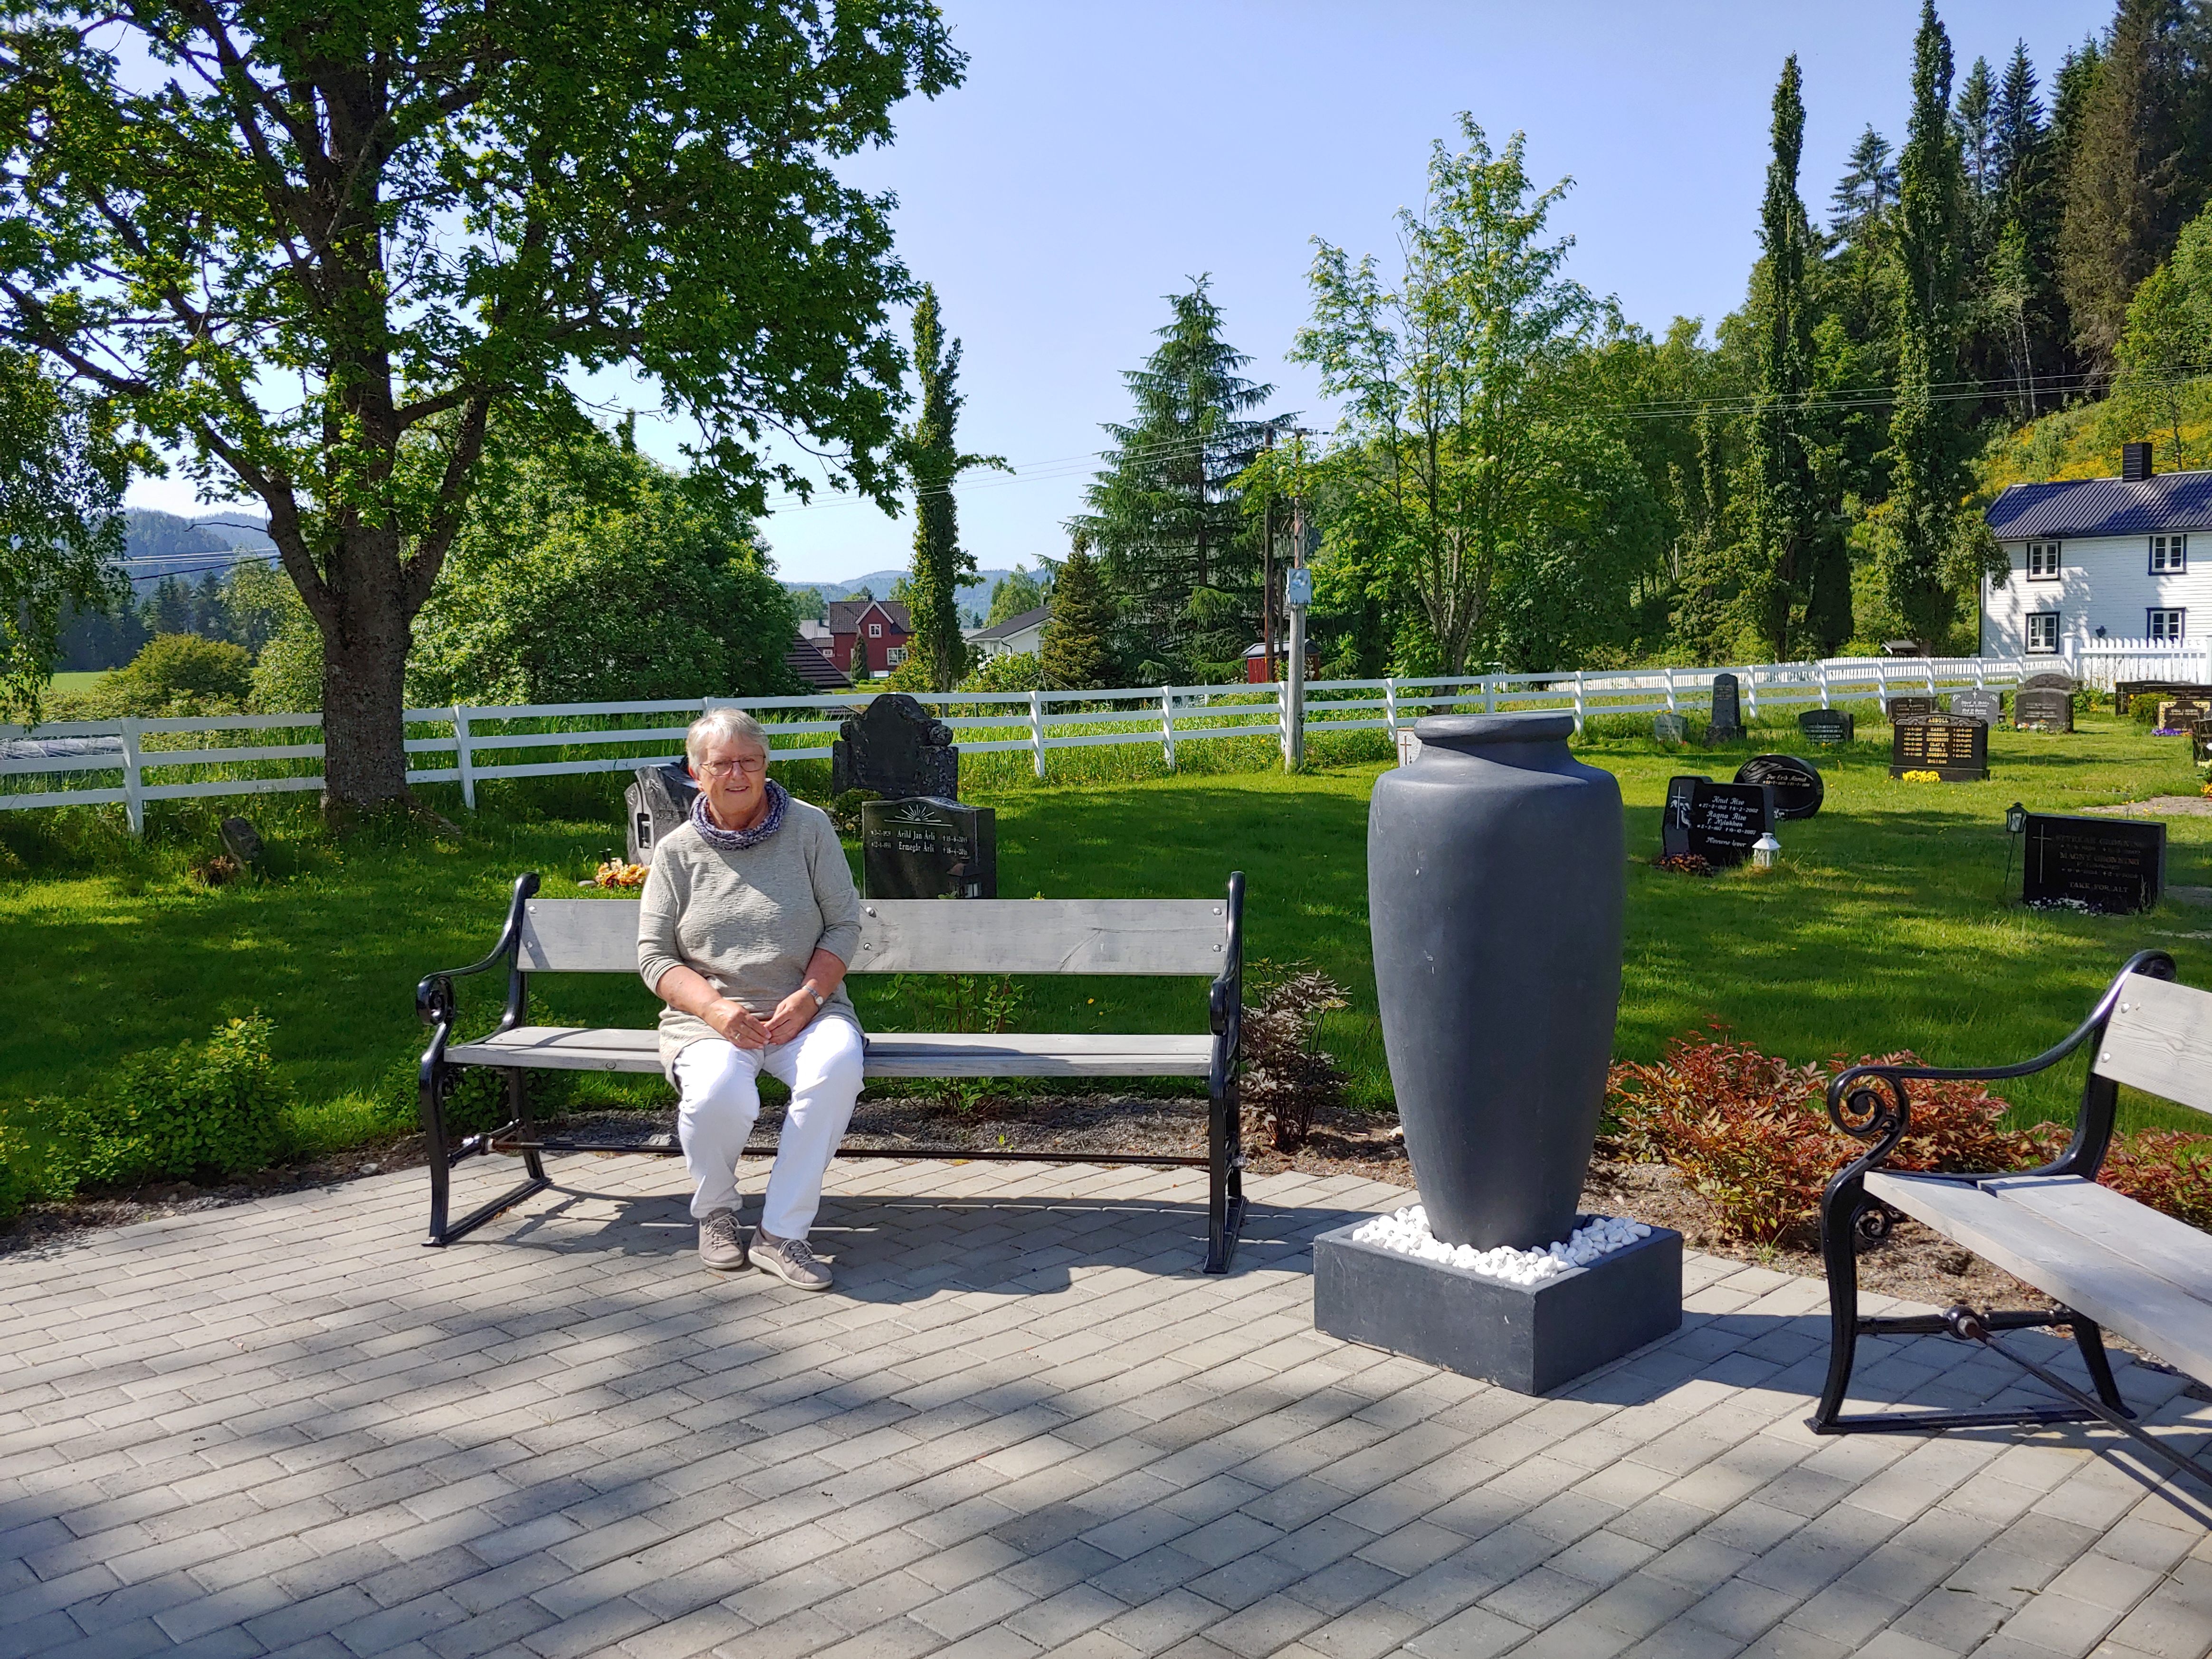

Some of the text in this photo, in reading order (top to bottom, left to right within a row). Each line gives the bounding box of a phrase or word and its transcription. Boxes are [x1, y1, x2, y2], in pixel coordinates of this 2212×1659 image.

[897, 830, 912, 838] Arild
[913, 830, 922, 840] Jan
[2093, 883, 2109, 891] FOR
